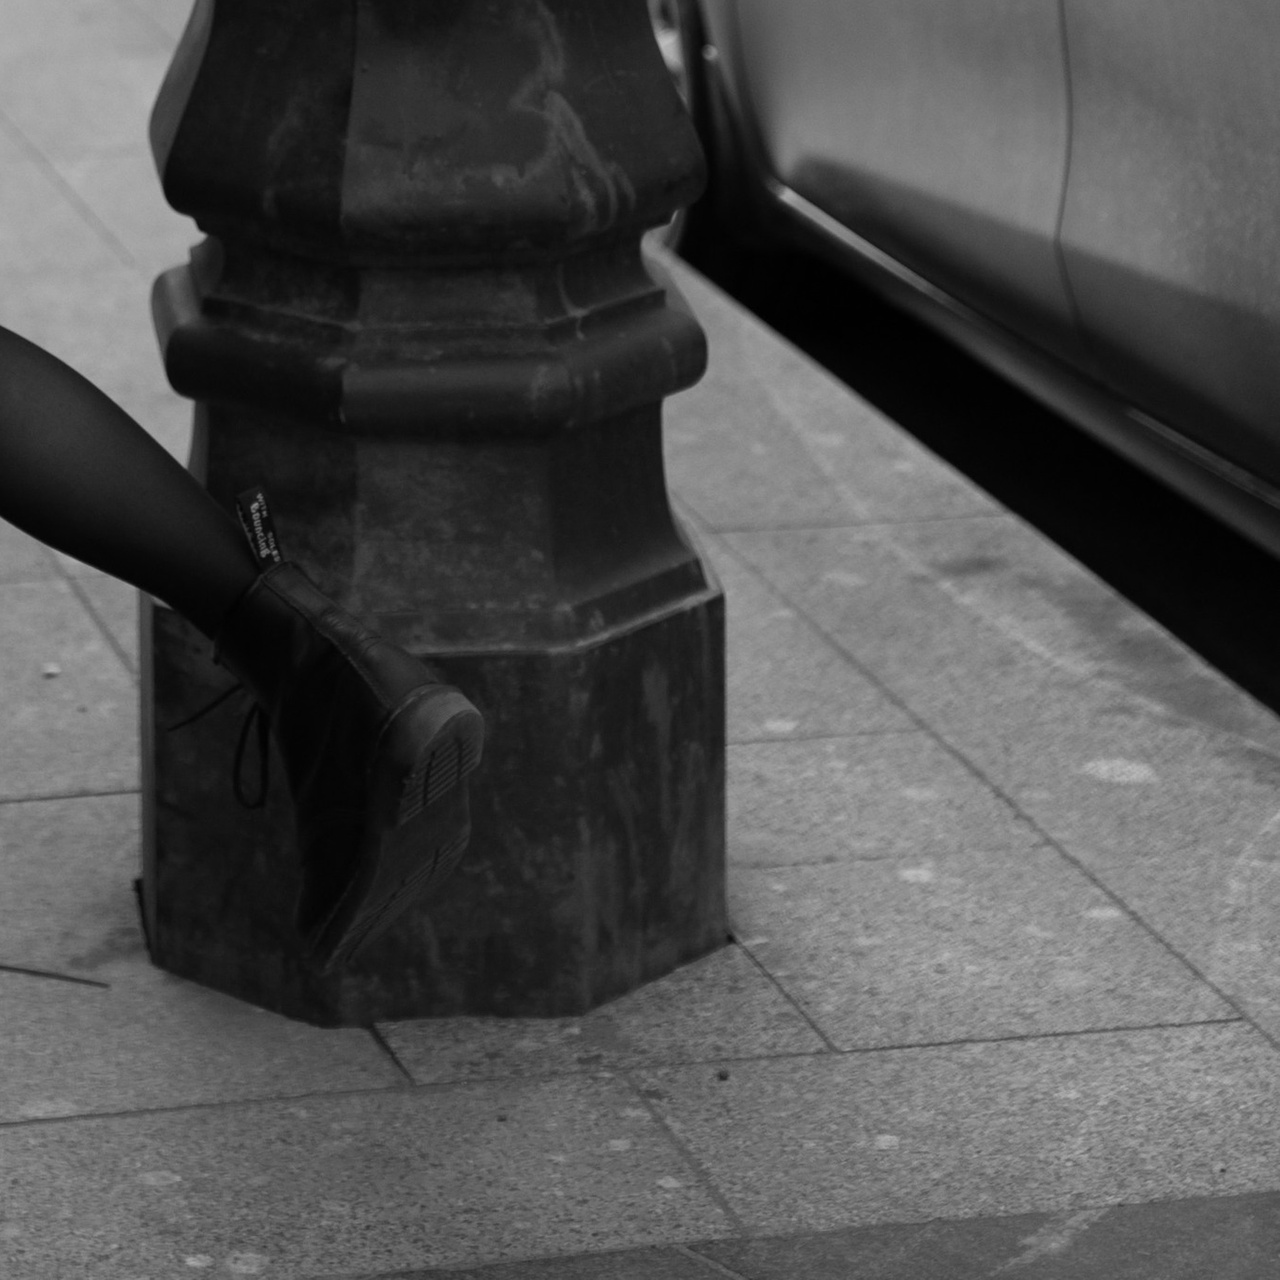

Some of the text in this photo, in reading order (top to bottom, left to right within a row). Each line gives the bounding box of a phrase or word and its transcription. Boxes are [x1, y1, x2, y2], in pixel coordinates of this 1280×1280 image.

[250, 502, 271, 558] Bouncing
[256, 493, 281, 562] WITH SOLES
